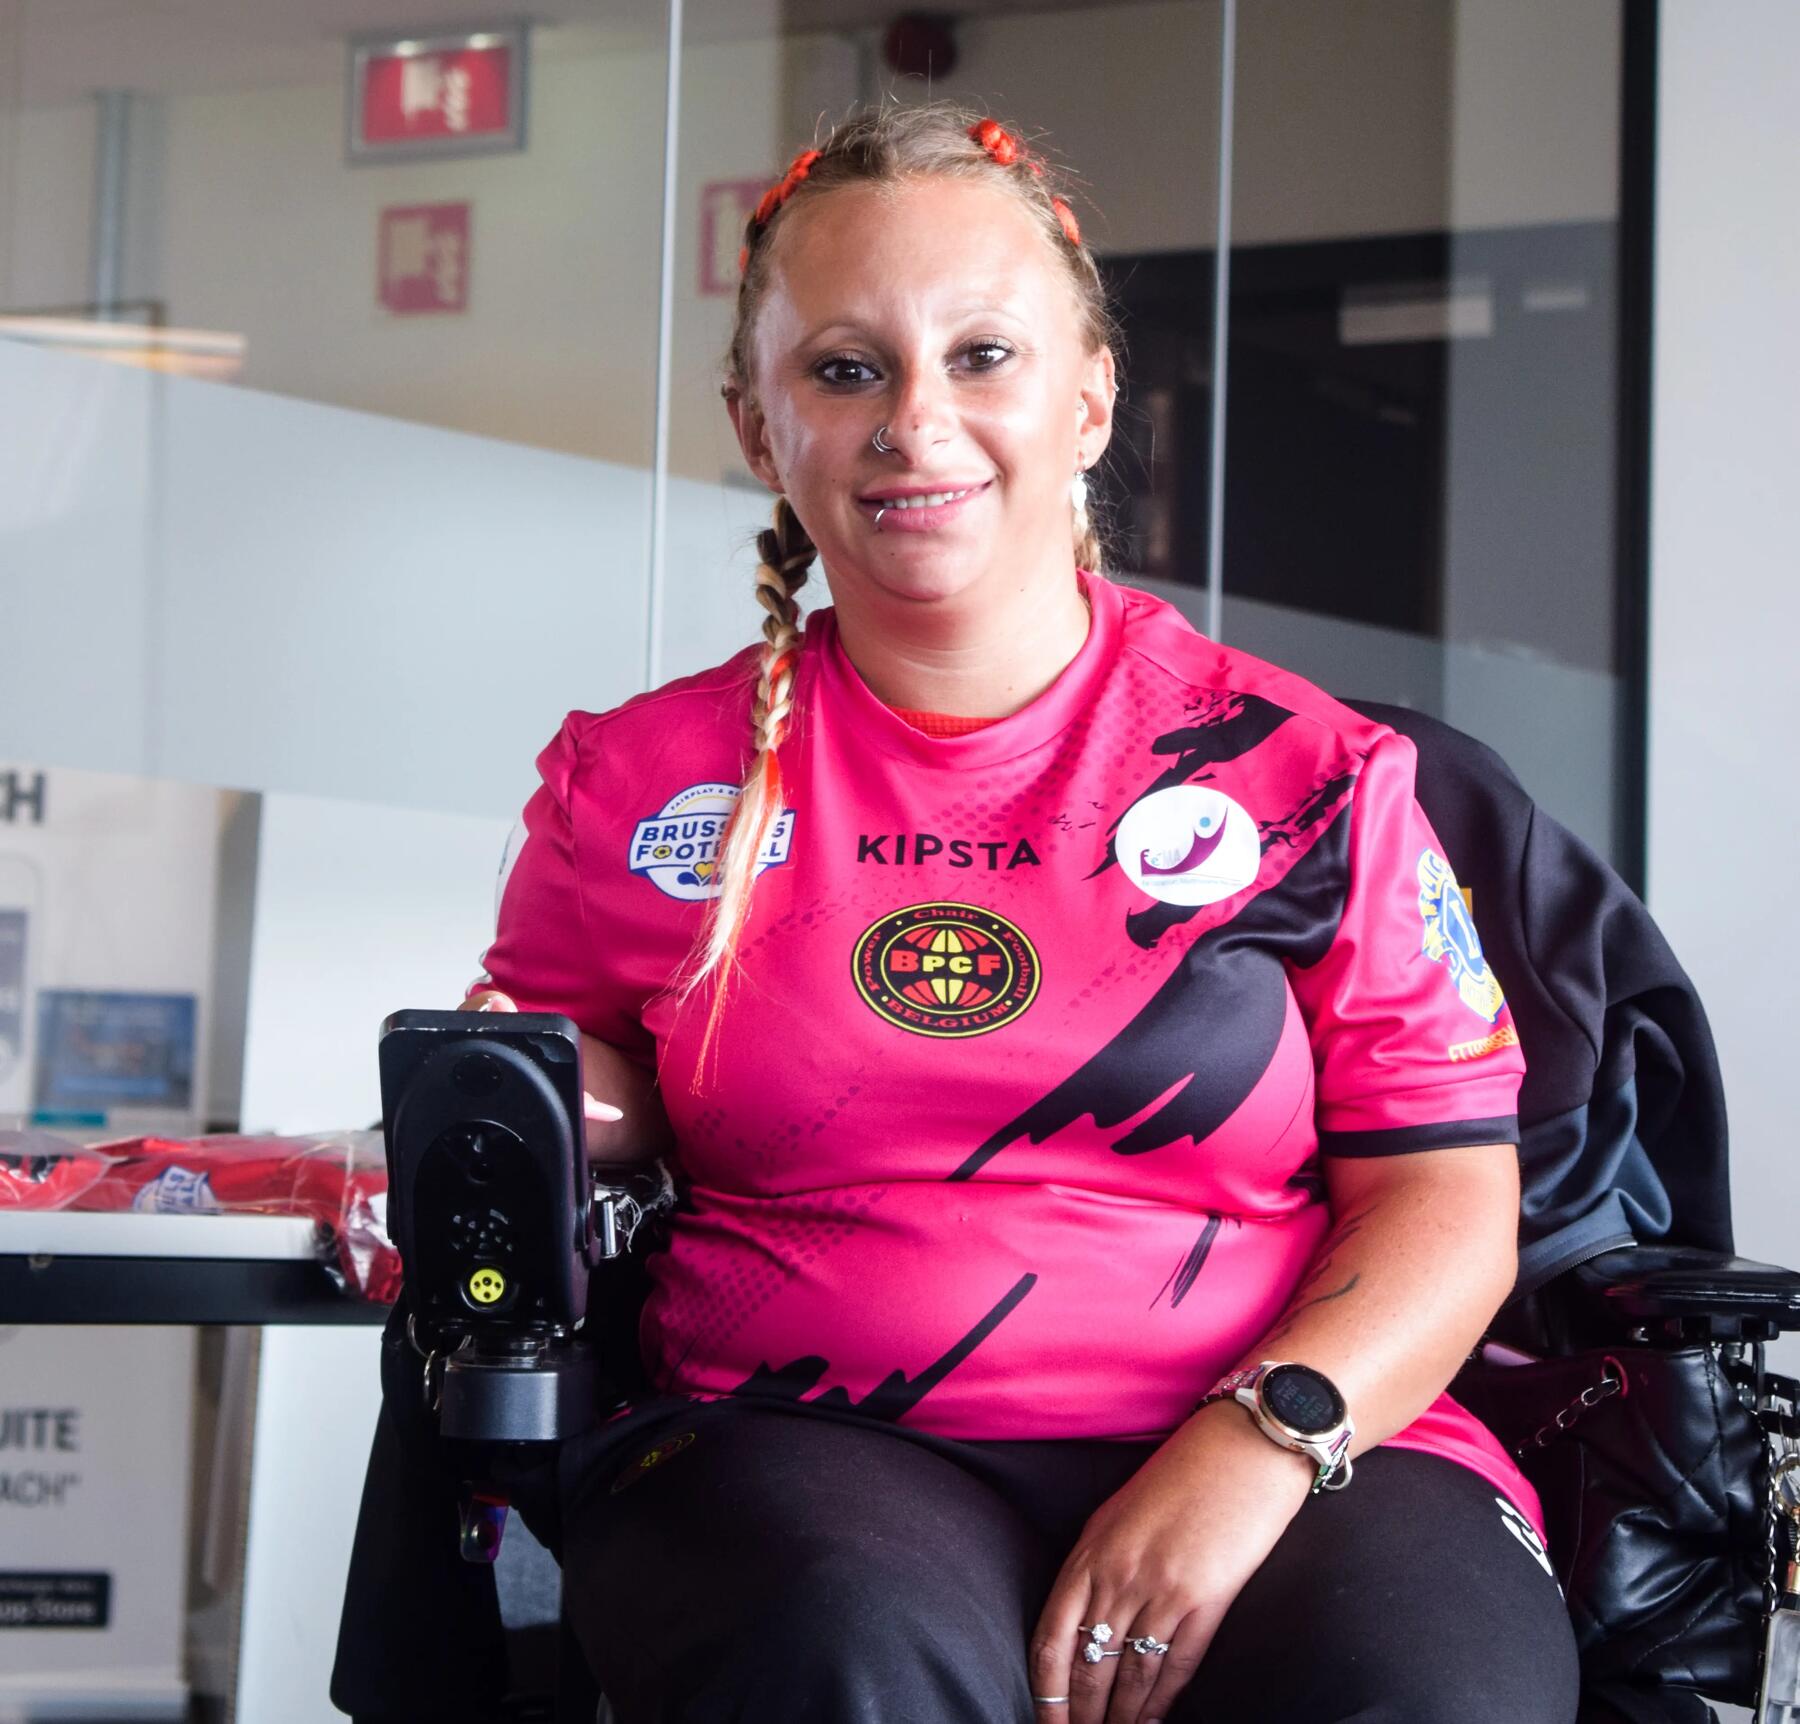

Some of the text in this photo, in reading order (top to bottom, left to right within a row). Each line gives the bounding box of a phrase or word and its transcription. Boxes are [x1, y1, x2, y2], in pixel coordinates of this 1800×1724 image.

[670, 787, 714, 810] FAIRPLAY
[857, 833, 1042, 871] KIPSTA
[863, 908, 1030, 999] Power Chair Football
[886, 999, 1010, 1028] BELGIUM
